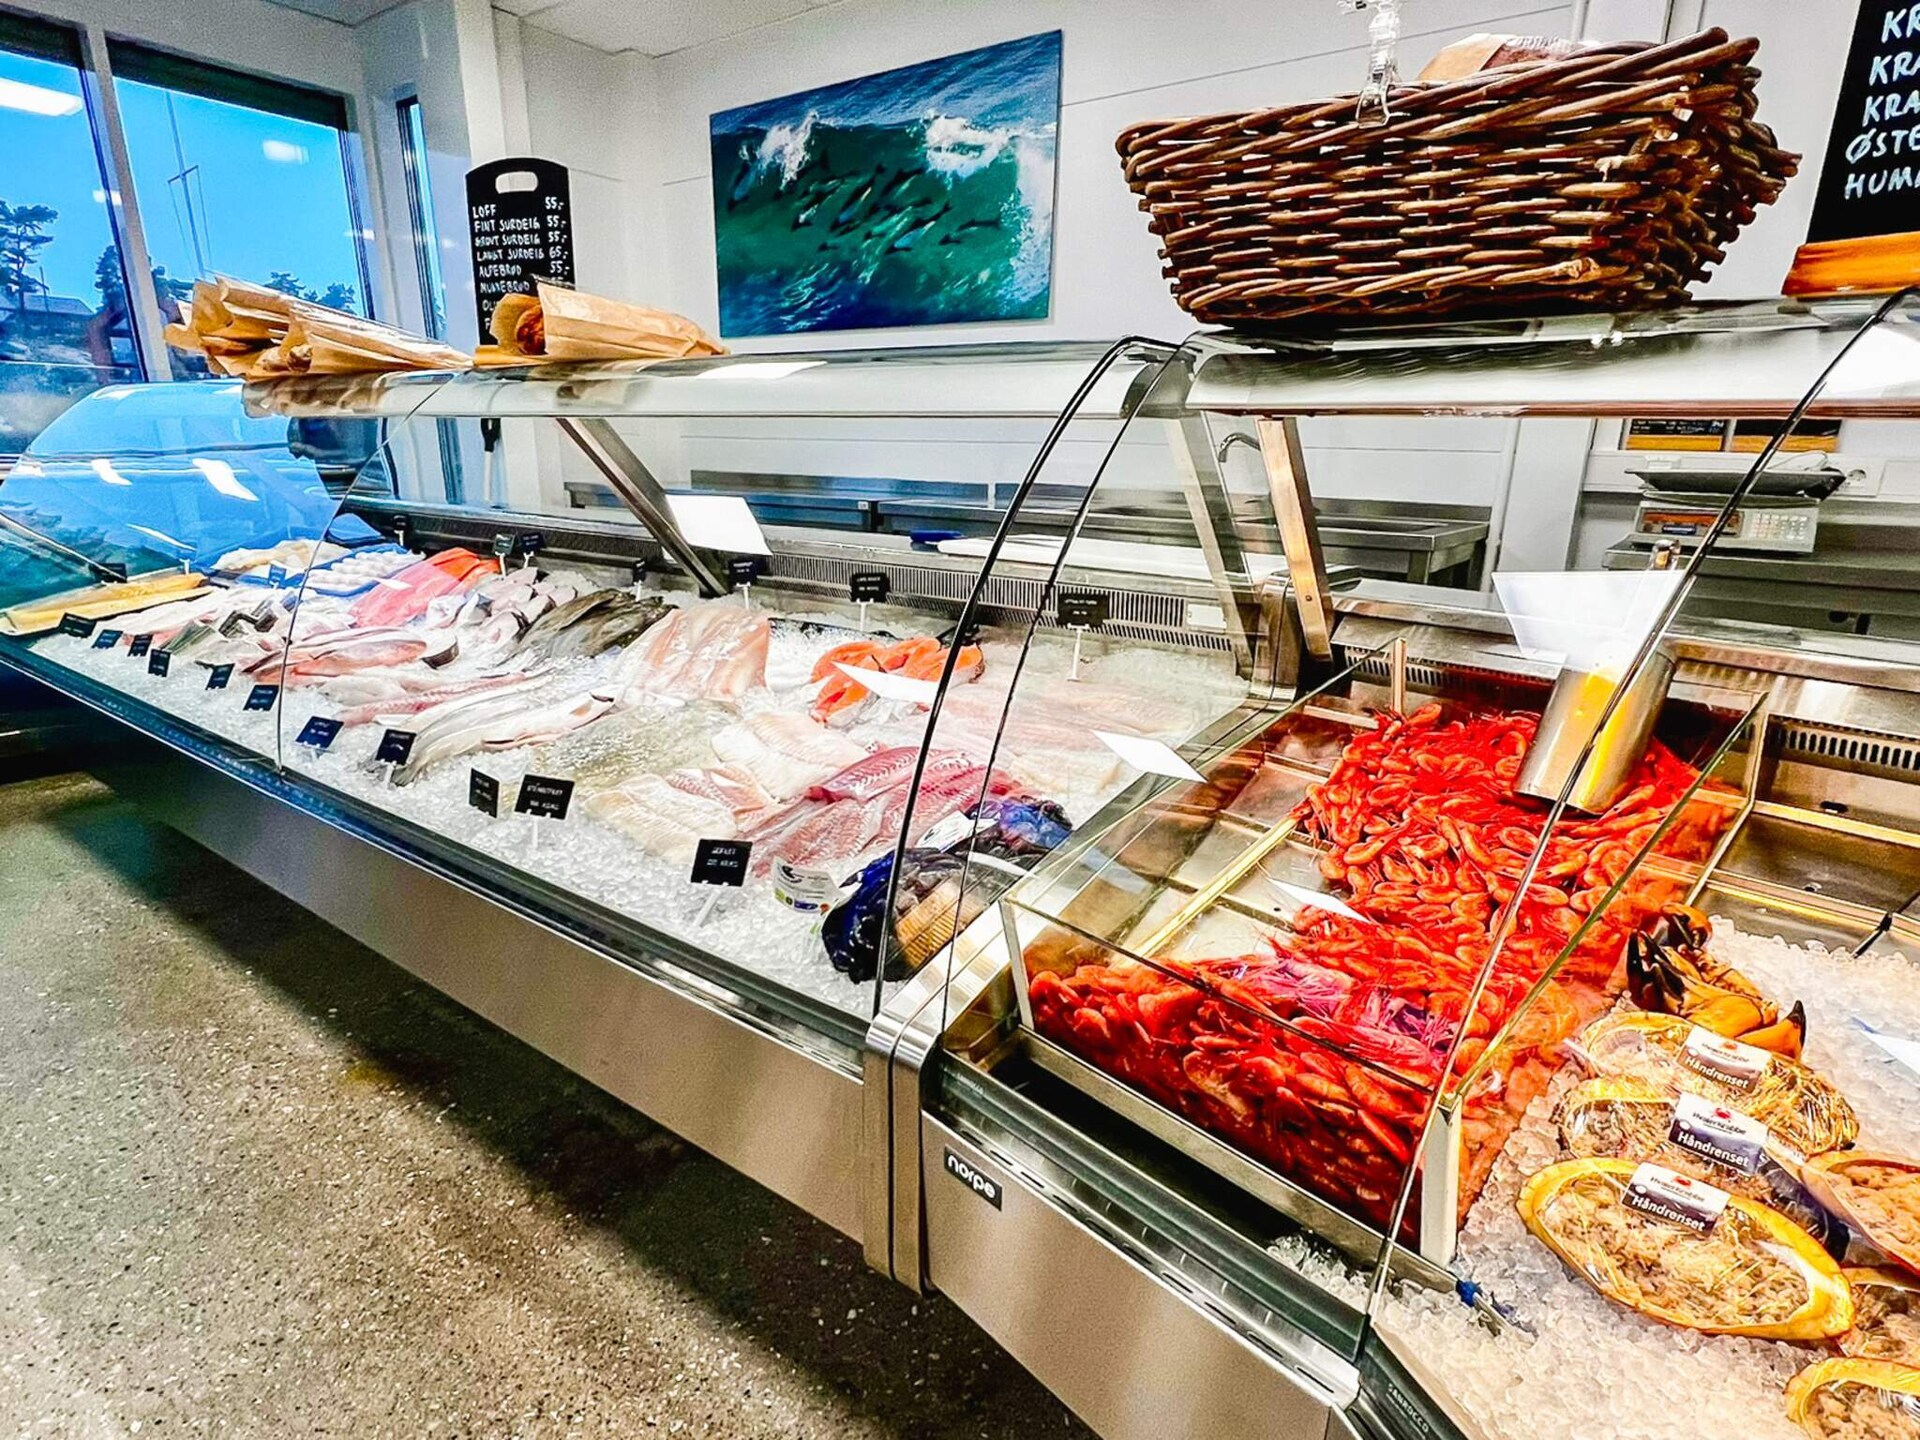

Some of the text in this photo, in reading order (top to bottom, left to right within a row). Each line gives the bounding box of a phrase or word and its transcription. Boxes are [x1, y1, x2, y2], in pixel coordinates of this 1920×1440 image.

[472, 204, 496, 219] LOFF
[474, 219, 496, 232] FINT
[499, 217, 540, 232] SURDEIG
[502, 233, 540, 246] SURDEIG
[507, 248, 544, 260] SURDEIG
[1684, 1056, 1749, 1089] Håndrenset
[1677, 1131, 1750, 1167] Håndrenset
[947, 1155, 996, 1198] norpe
[1632, 1195, 1706, 1232] Håndrenset
